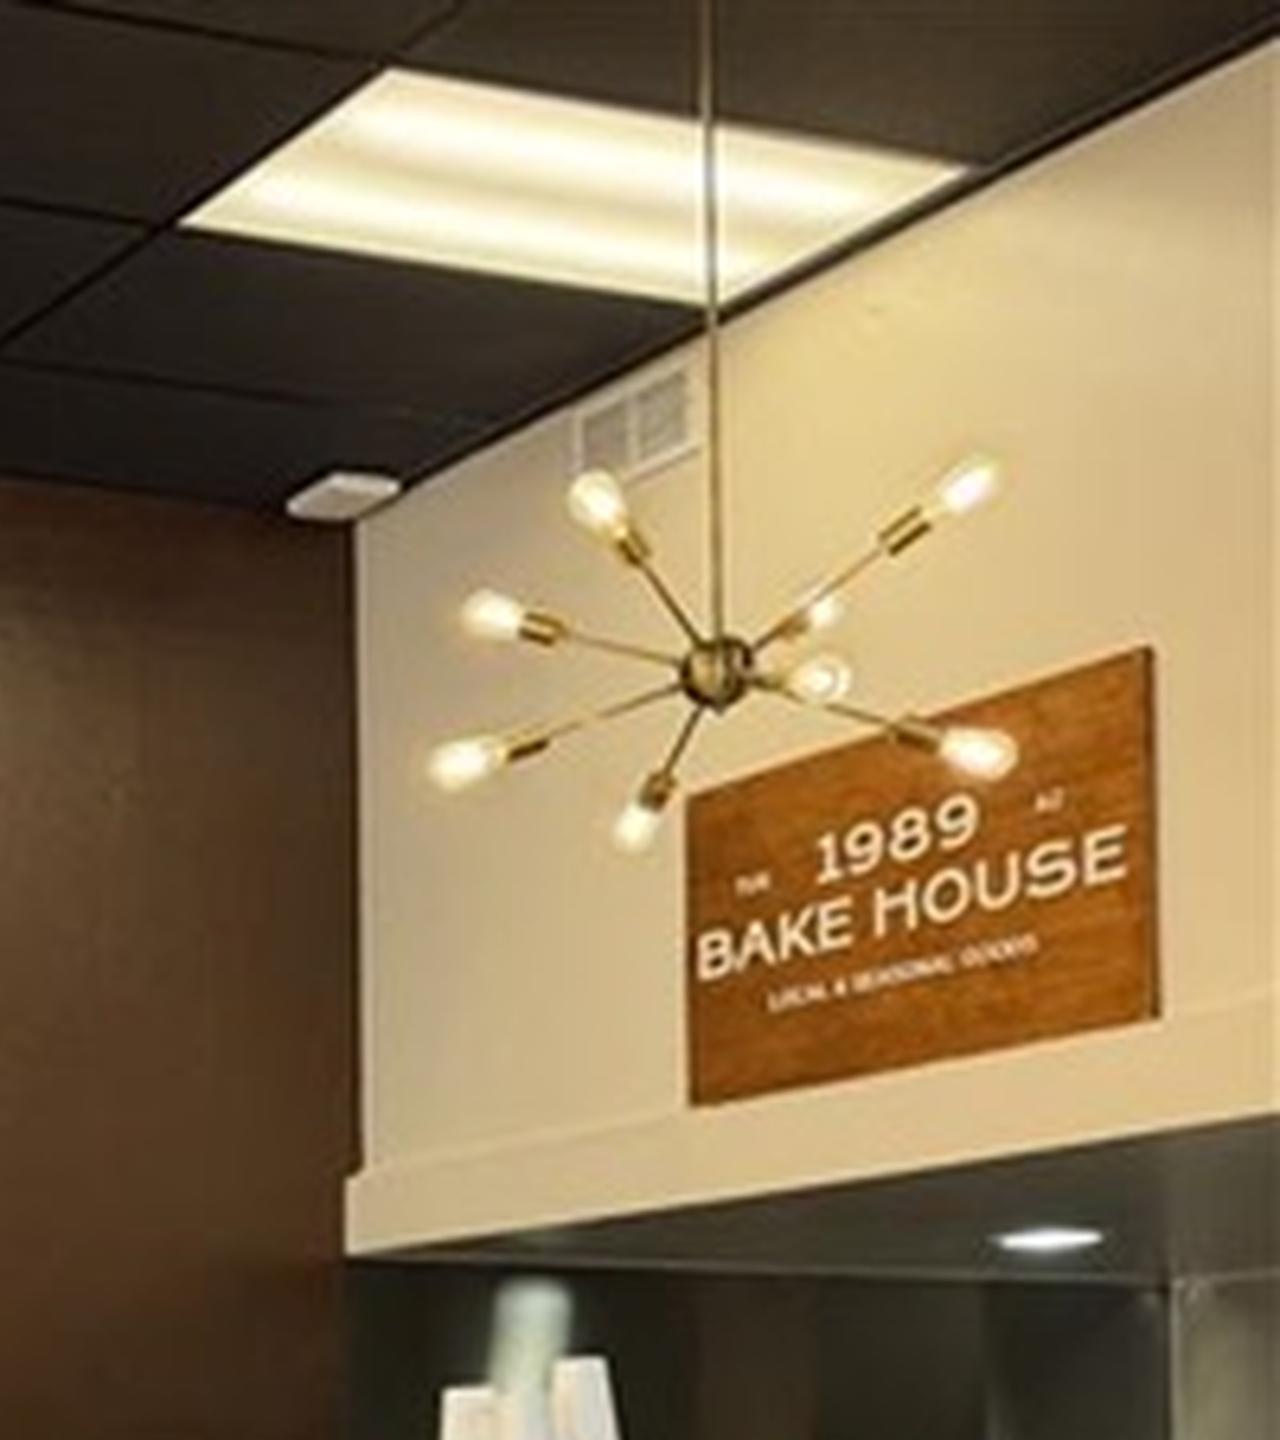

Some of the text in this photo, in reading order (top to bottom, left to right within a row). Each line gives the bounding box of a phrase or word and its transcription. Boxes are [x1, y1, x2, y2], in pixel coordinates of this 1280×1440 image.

[814, 793, 980, 885] 1989
[697, 823, 1129, 982] BAKE HOUSE
